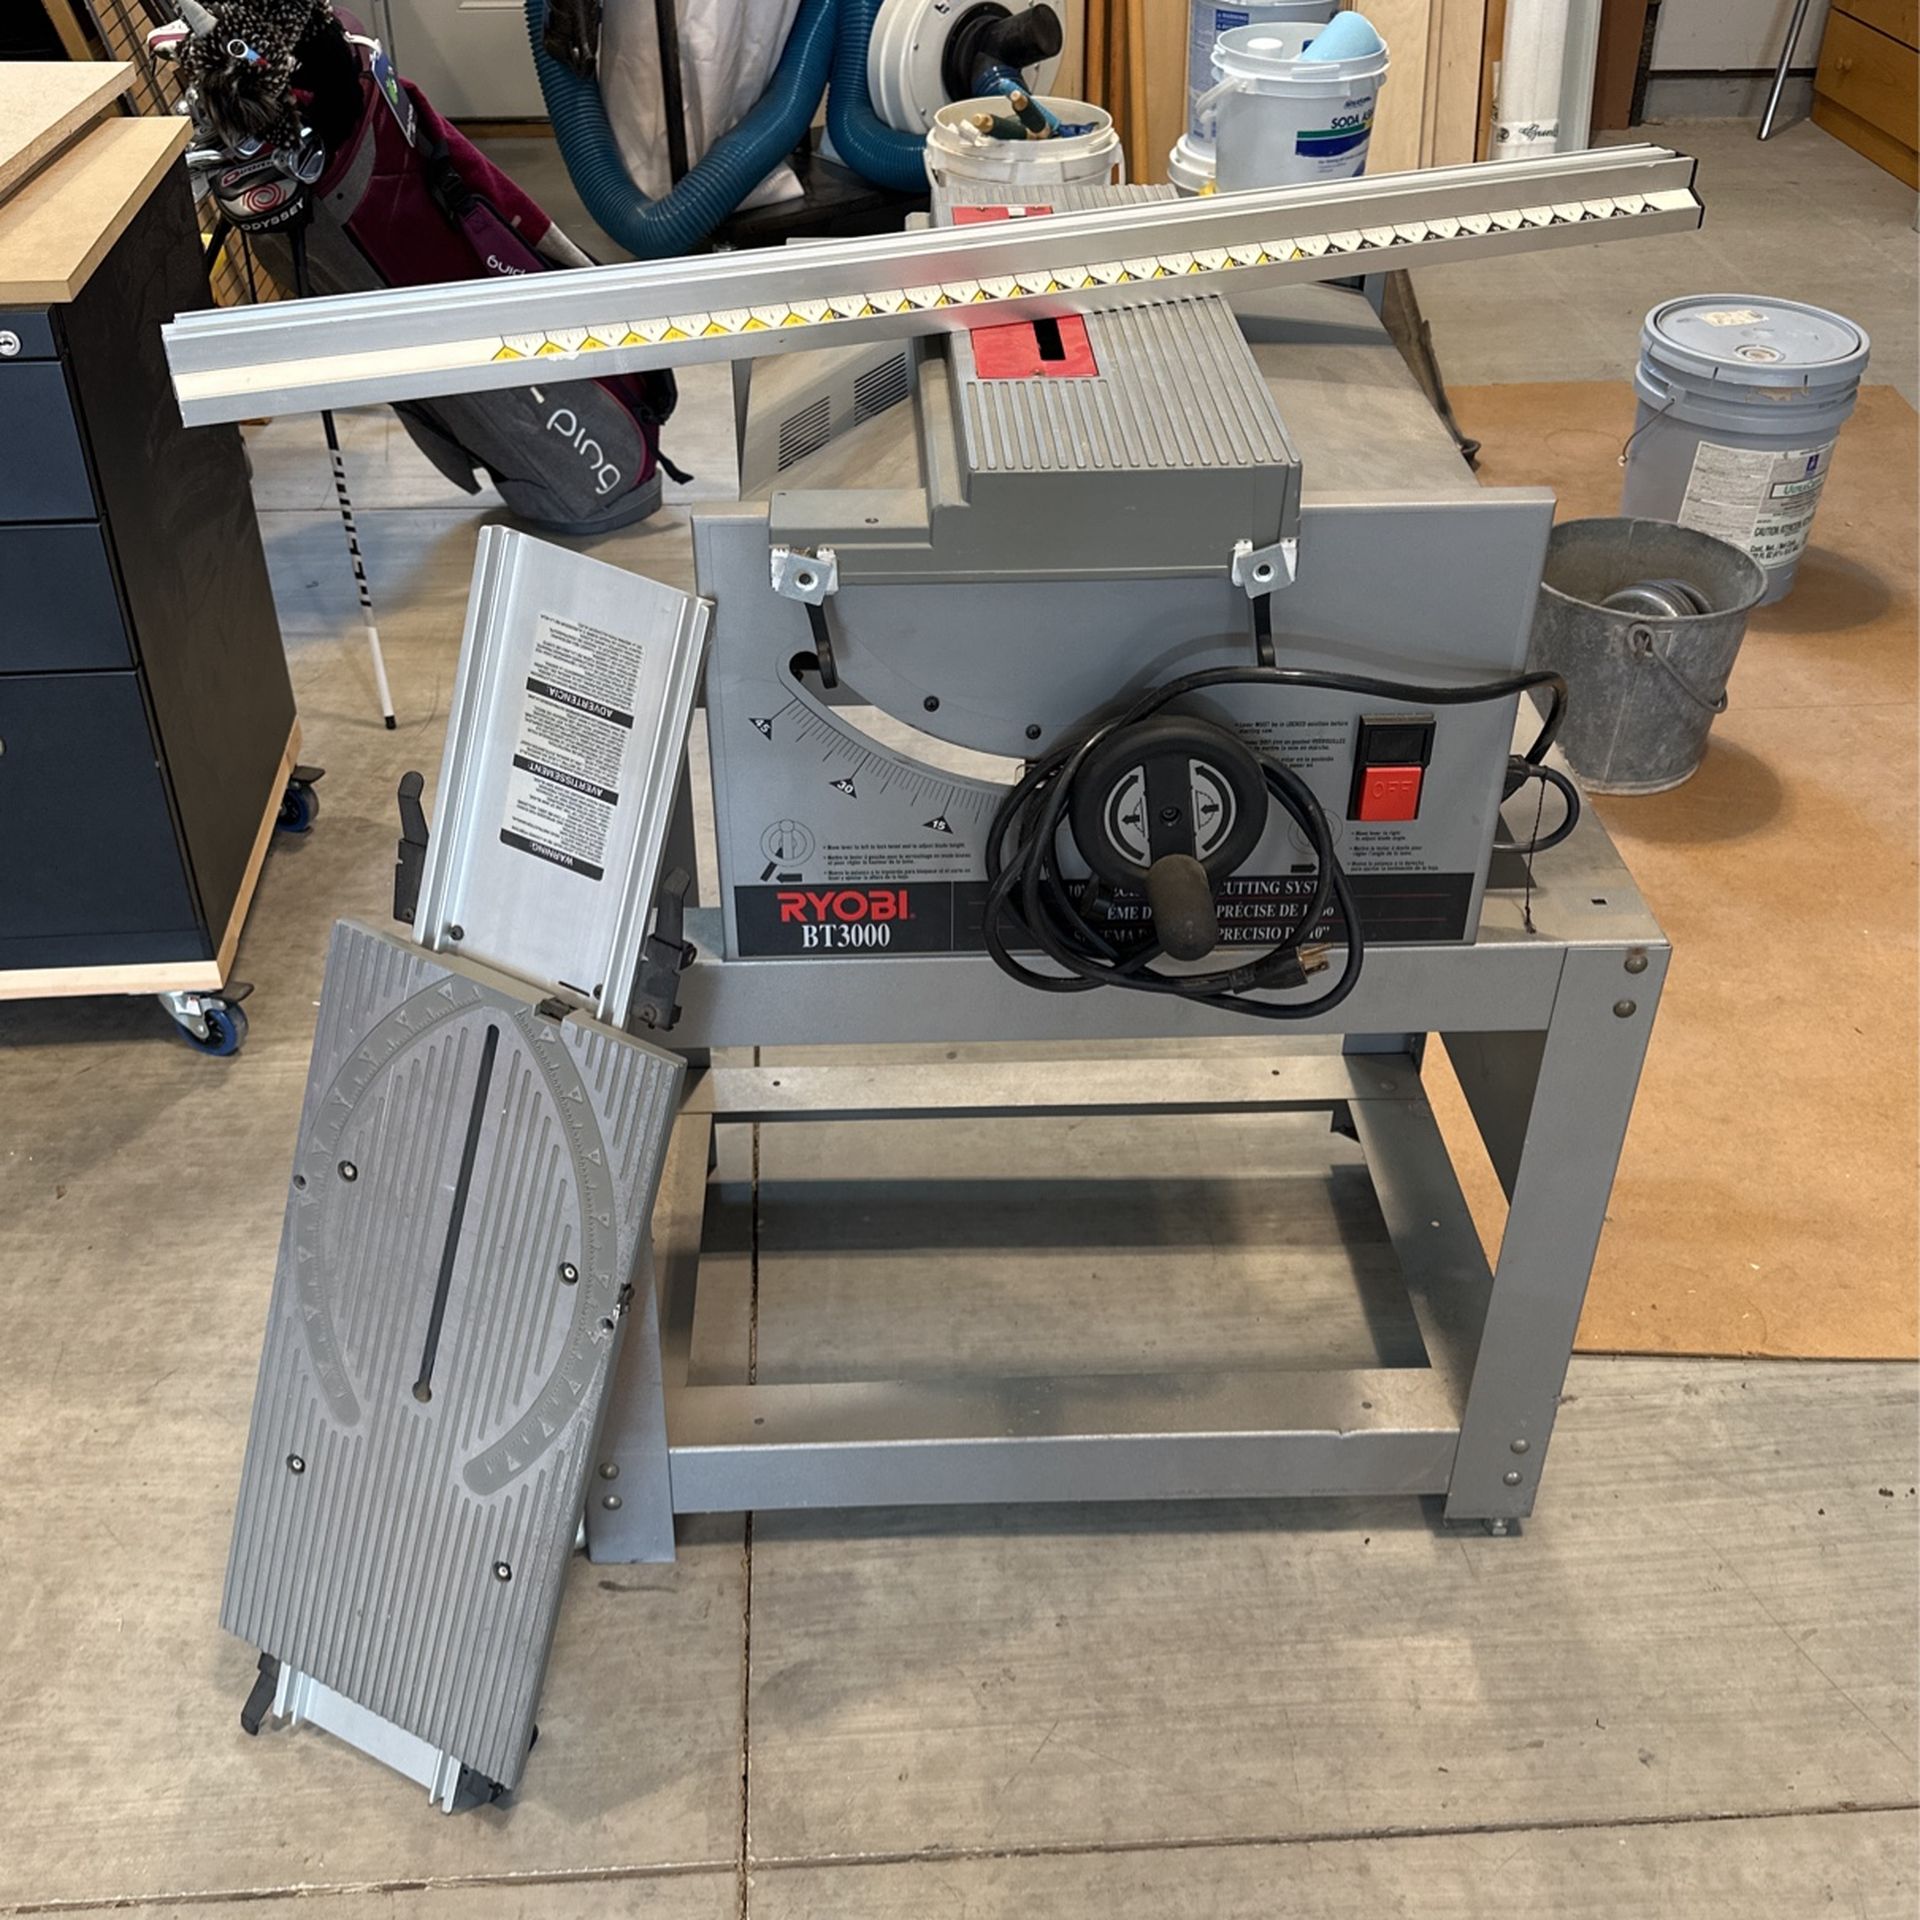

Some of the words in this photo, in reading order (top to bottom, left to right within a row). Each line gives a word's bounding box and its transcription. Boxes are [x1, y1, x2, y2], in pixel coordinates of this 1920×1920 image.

[1331, 114, 1359, 129] SODA
[241, 198, 304, 231] ODYSSEY
[546, 408, 621, 494] ping
[755, 718, 771, 734] 45
[837, 781, 854, 794] 30
[1373, 780, 1413, 798] OFF
[932, 819, 947, 831] 15
[1285, 880, 1318, 896] SYST
[777, 890, 908, 922] RYOBI
[1279, 903, 1300, 917] DE
[802, 923, 891, 948] BT3000
